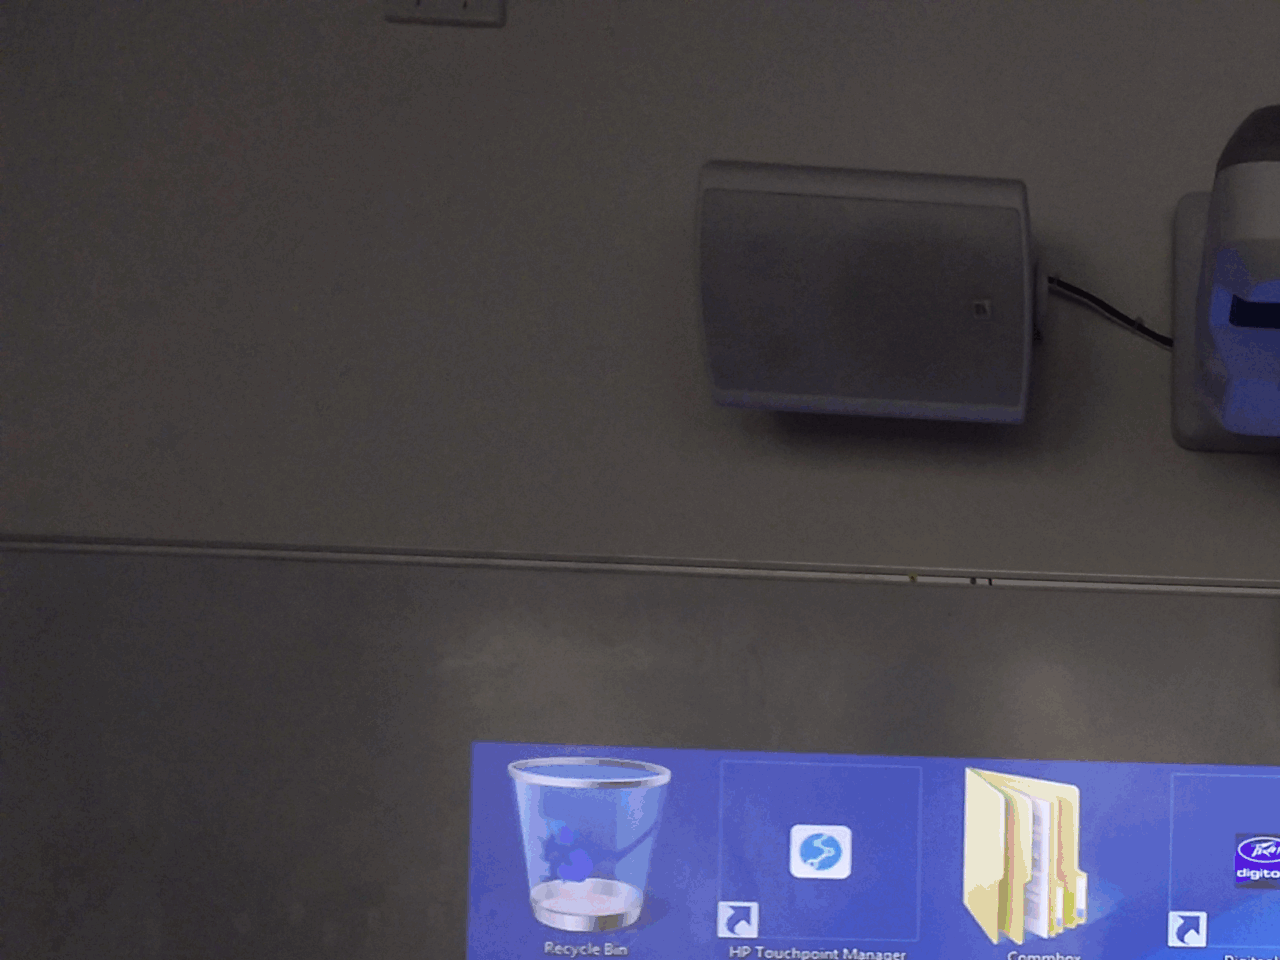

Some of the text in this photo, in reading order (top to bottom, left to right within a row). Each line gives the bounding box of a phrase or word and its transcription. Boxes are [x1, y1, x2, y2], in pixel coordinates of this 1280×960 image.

[545, 941, 628, 959] Recycle Bin
[729, 946, 751, 959] HP
